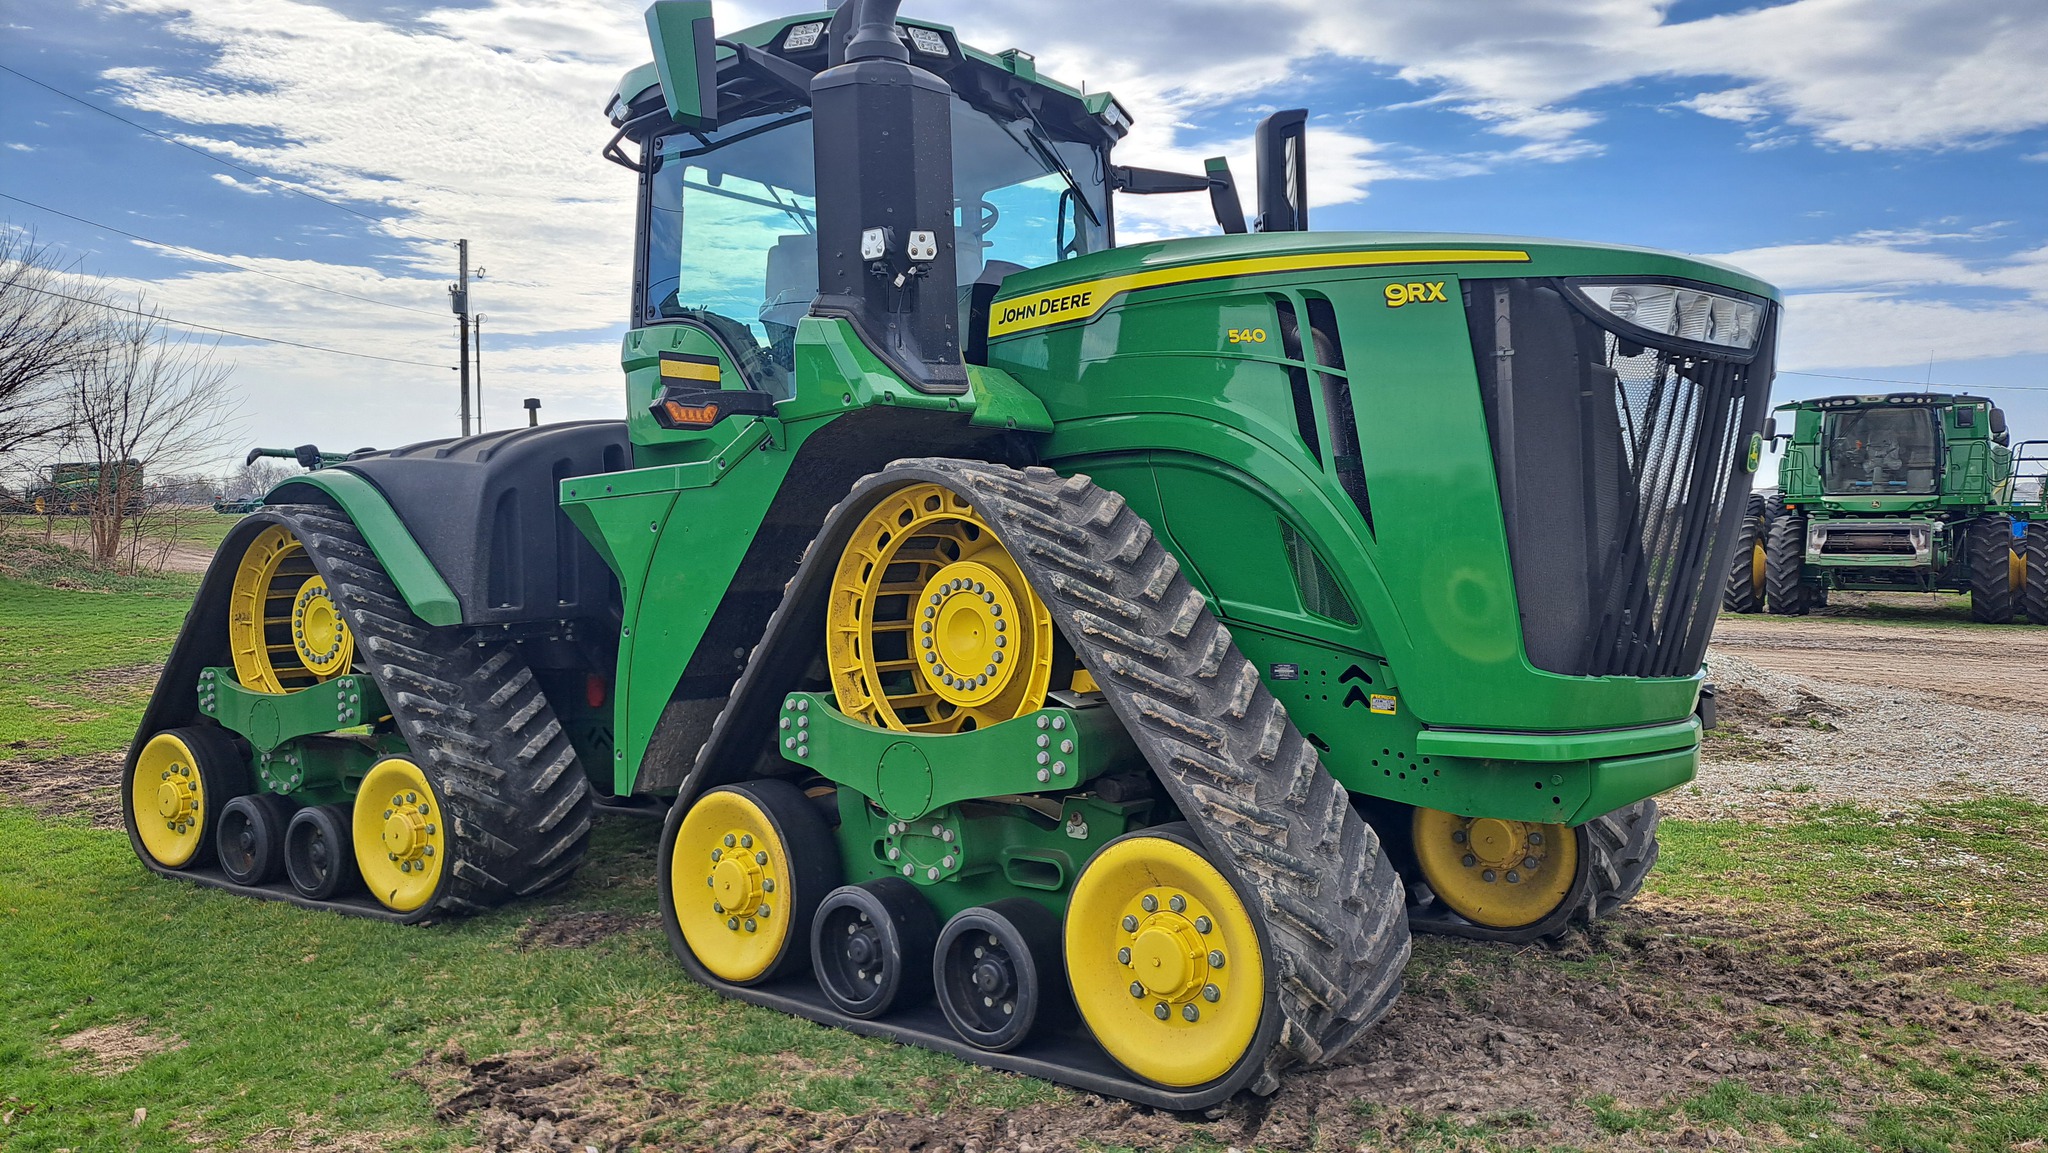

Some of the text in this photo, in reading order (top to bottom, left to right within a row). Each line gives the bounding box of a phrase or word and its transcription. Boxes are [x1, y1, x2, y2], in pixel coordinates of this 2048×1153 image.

[1384, 281, 1448, 307] 9RX
[998, 291, 1092, 325] JOHN DEERE
[1228, 328, 1267, 343] 540
